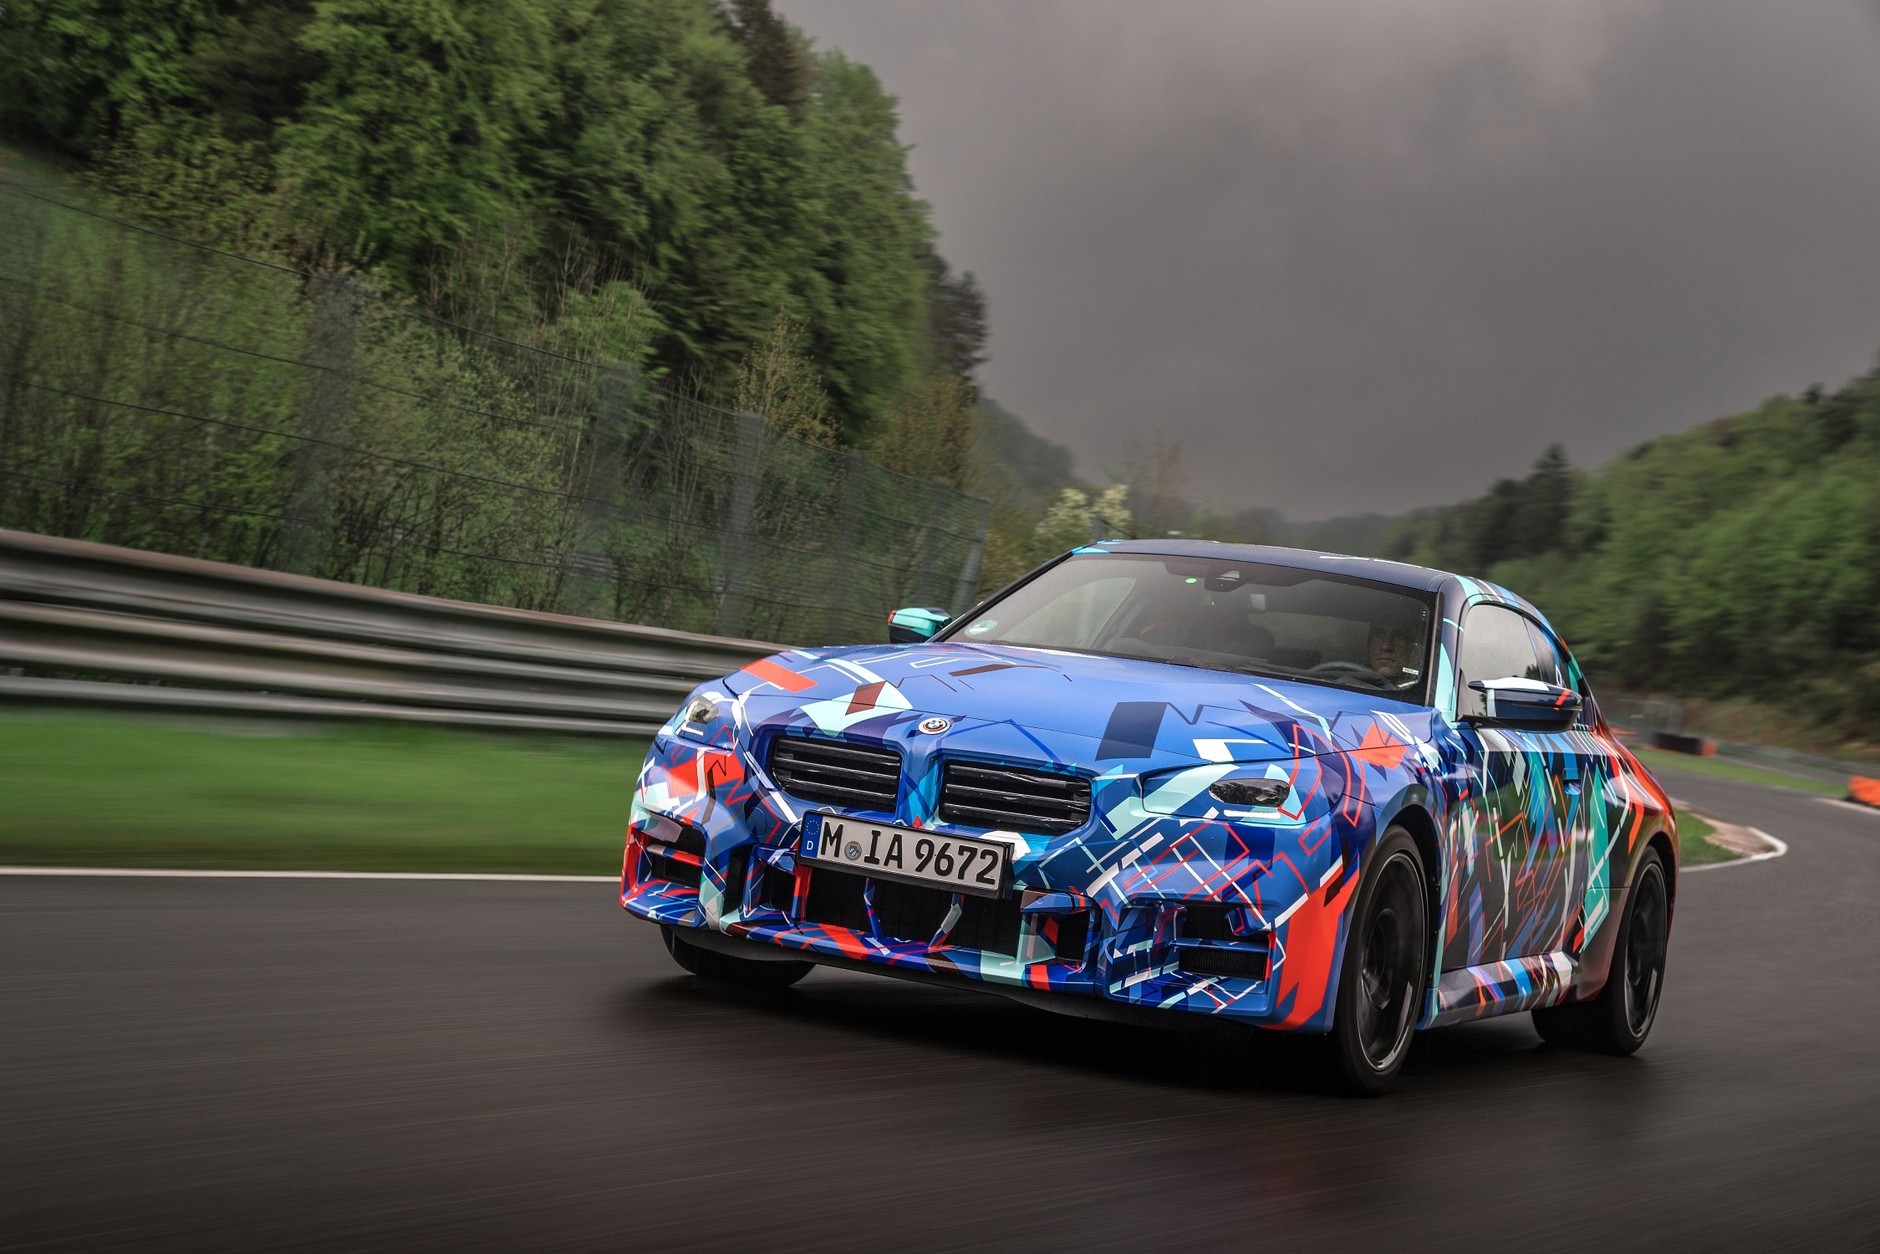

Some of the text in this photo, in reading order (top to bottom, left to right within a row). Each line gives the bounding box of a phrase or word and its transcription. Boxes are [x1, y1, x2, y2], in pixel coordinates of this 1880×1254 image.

[806, 840, 814, 851] D
[820, 821, 999, 885] M IA 9672
